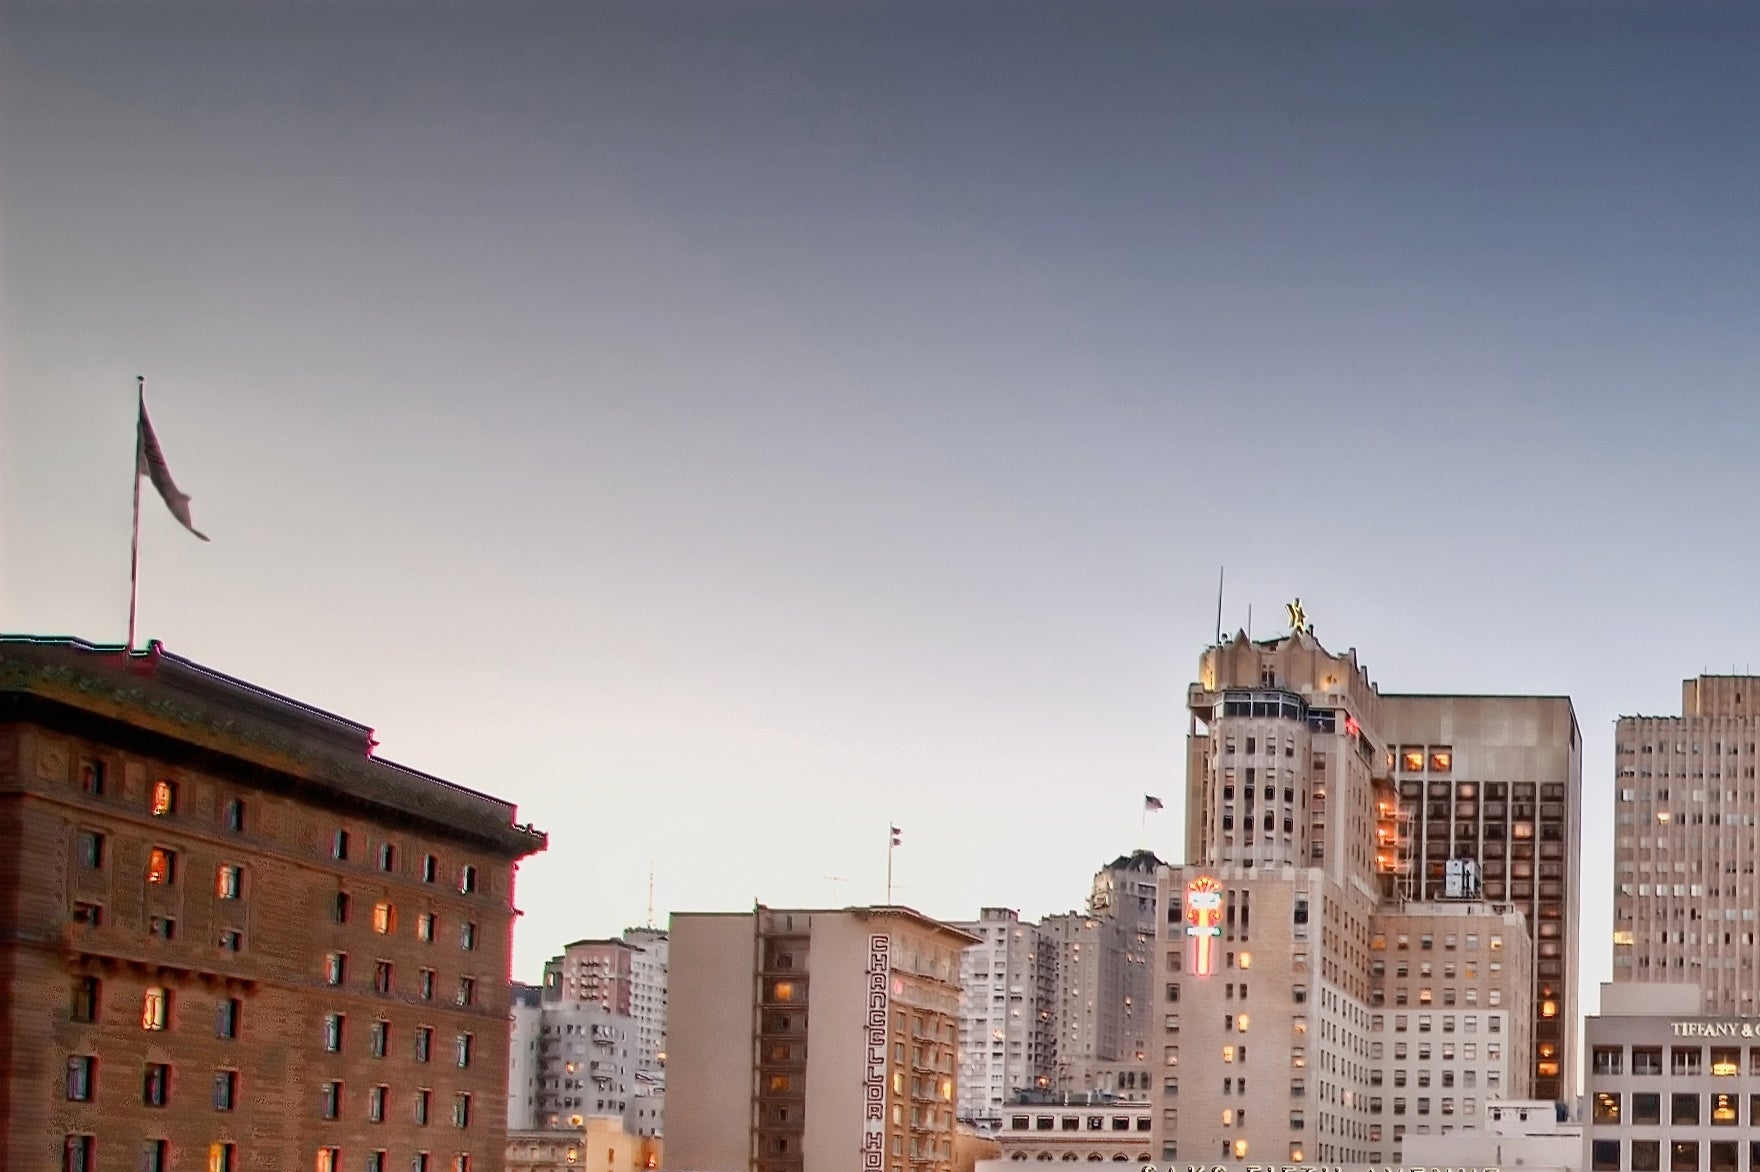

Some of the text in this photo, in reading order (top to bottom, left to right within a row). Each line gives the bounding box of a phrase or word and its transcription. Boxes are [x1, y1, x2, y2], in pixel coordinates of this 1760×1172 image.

[866, 935, 889, 1120] CHANCELLOR
[1671, 1022, 1739, 1038] TIFFANY
[1741, 1022, 1753, 1038] &
